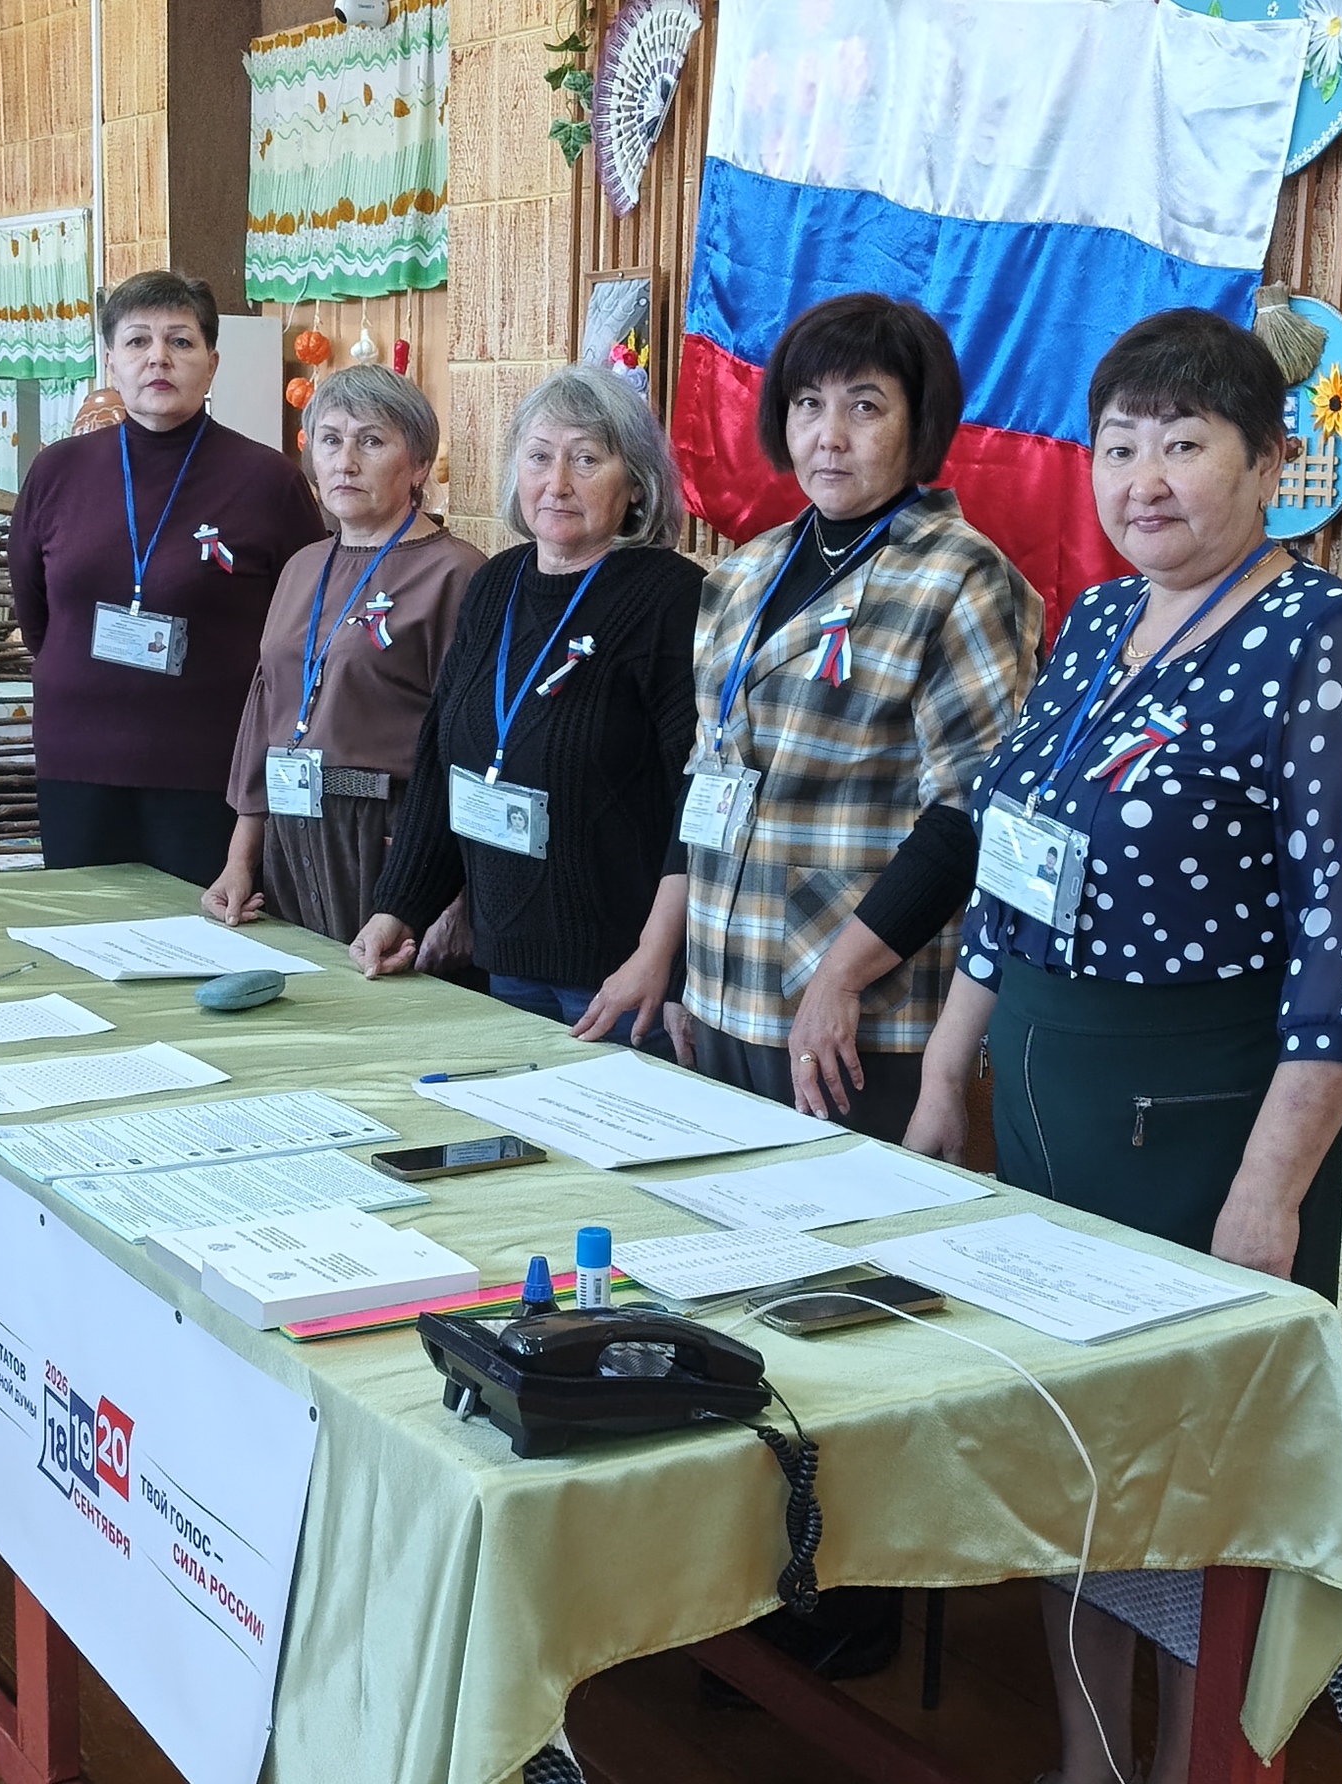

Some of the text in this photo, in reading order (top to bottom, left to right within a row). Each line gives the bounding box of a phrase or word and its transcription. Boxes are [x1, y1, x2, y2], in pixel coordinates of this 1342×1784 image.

[14, 1388, 37, 1420] ДУМЫ
[45, 1359, 69, 1397] 2026
[48, 1413, 129, 1479] 18 19 20
[73, 1487, 130, 1560] СЕНТЯБРЯ
[140, 1474, 168, 1519] ТВОЙ
[170, 1505, 211, 1557] ГОЛОС
[173, 1542, 266, 1646] СИЛА РОССИИ!
